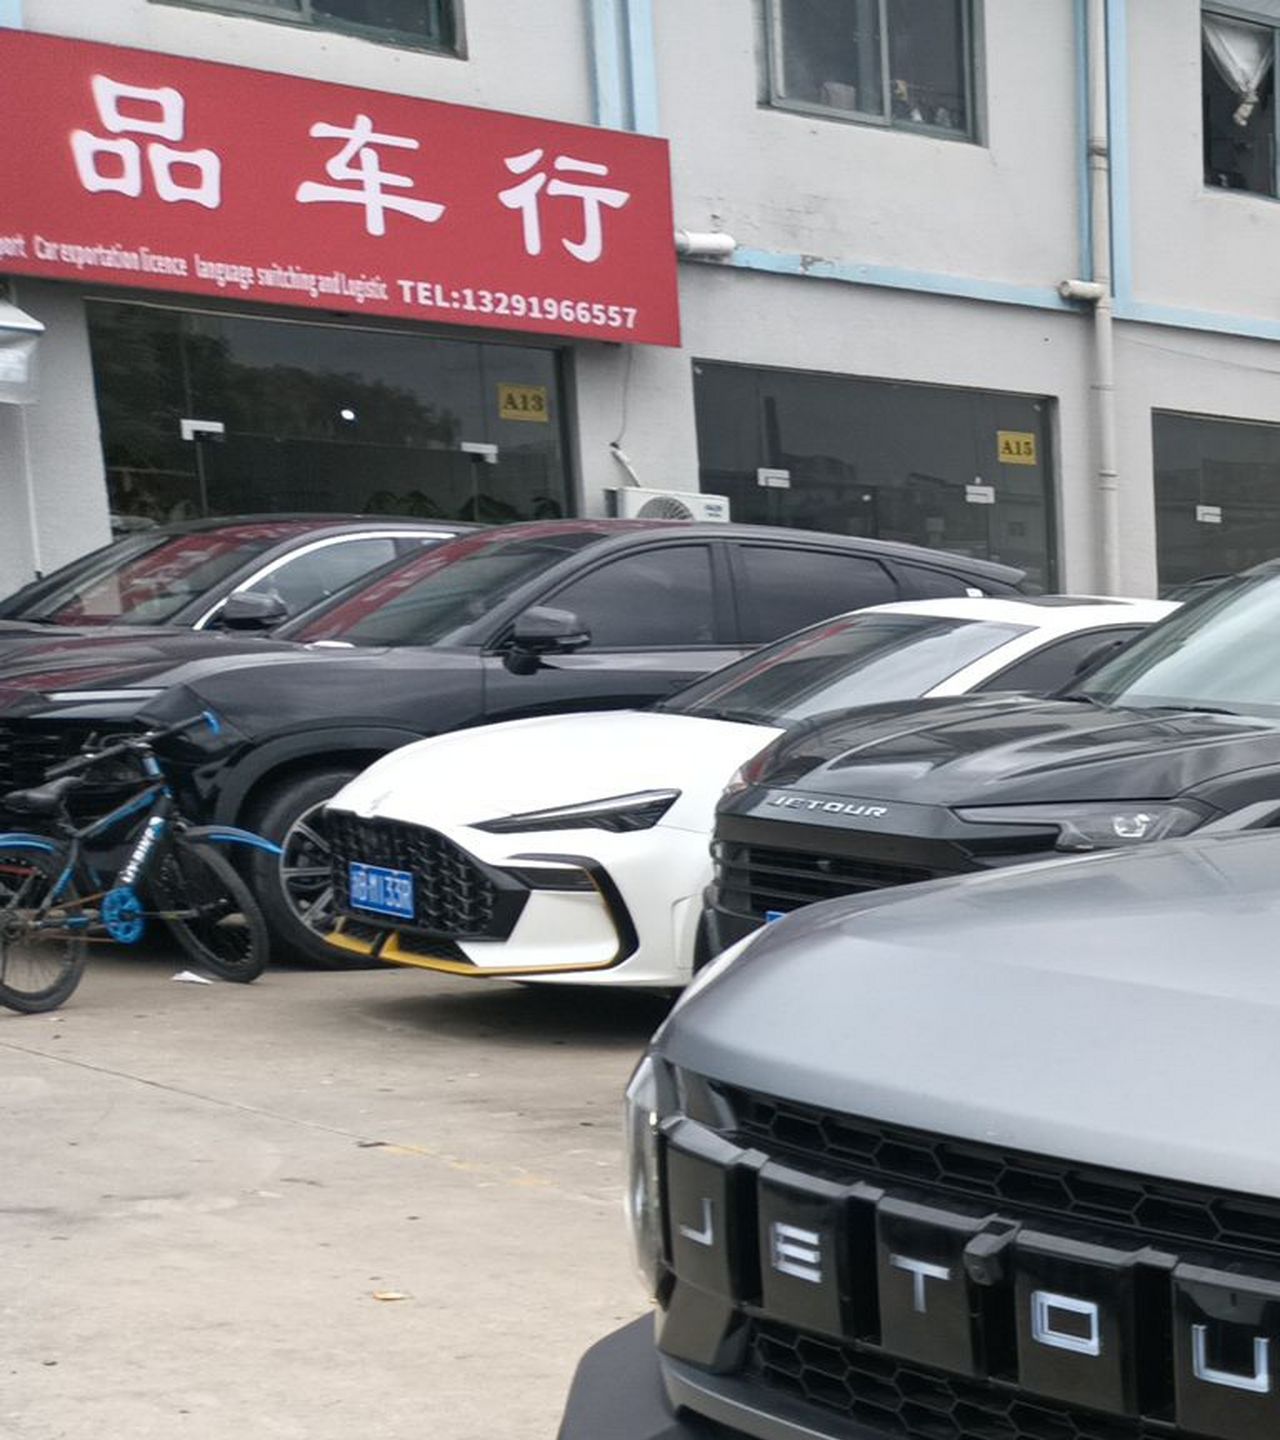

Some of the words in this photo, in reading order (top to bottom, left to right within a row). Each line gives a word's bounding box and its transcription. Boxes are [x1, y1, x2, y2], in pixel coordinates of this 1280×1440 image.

[397, 279, 638, 329] TEL:13291966557
[503, 393, 544, 411] A13
[1001, 439, 1032, 457] A15
[767, 796, 888, 818] JETOUR
